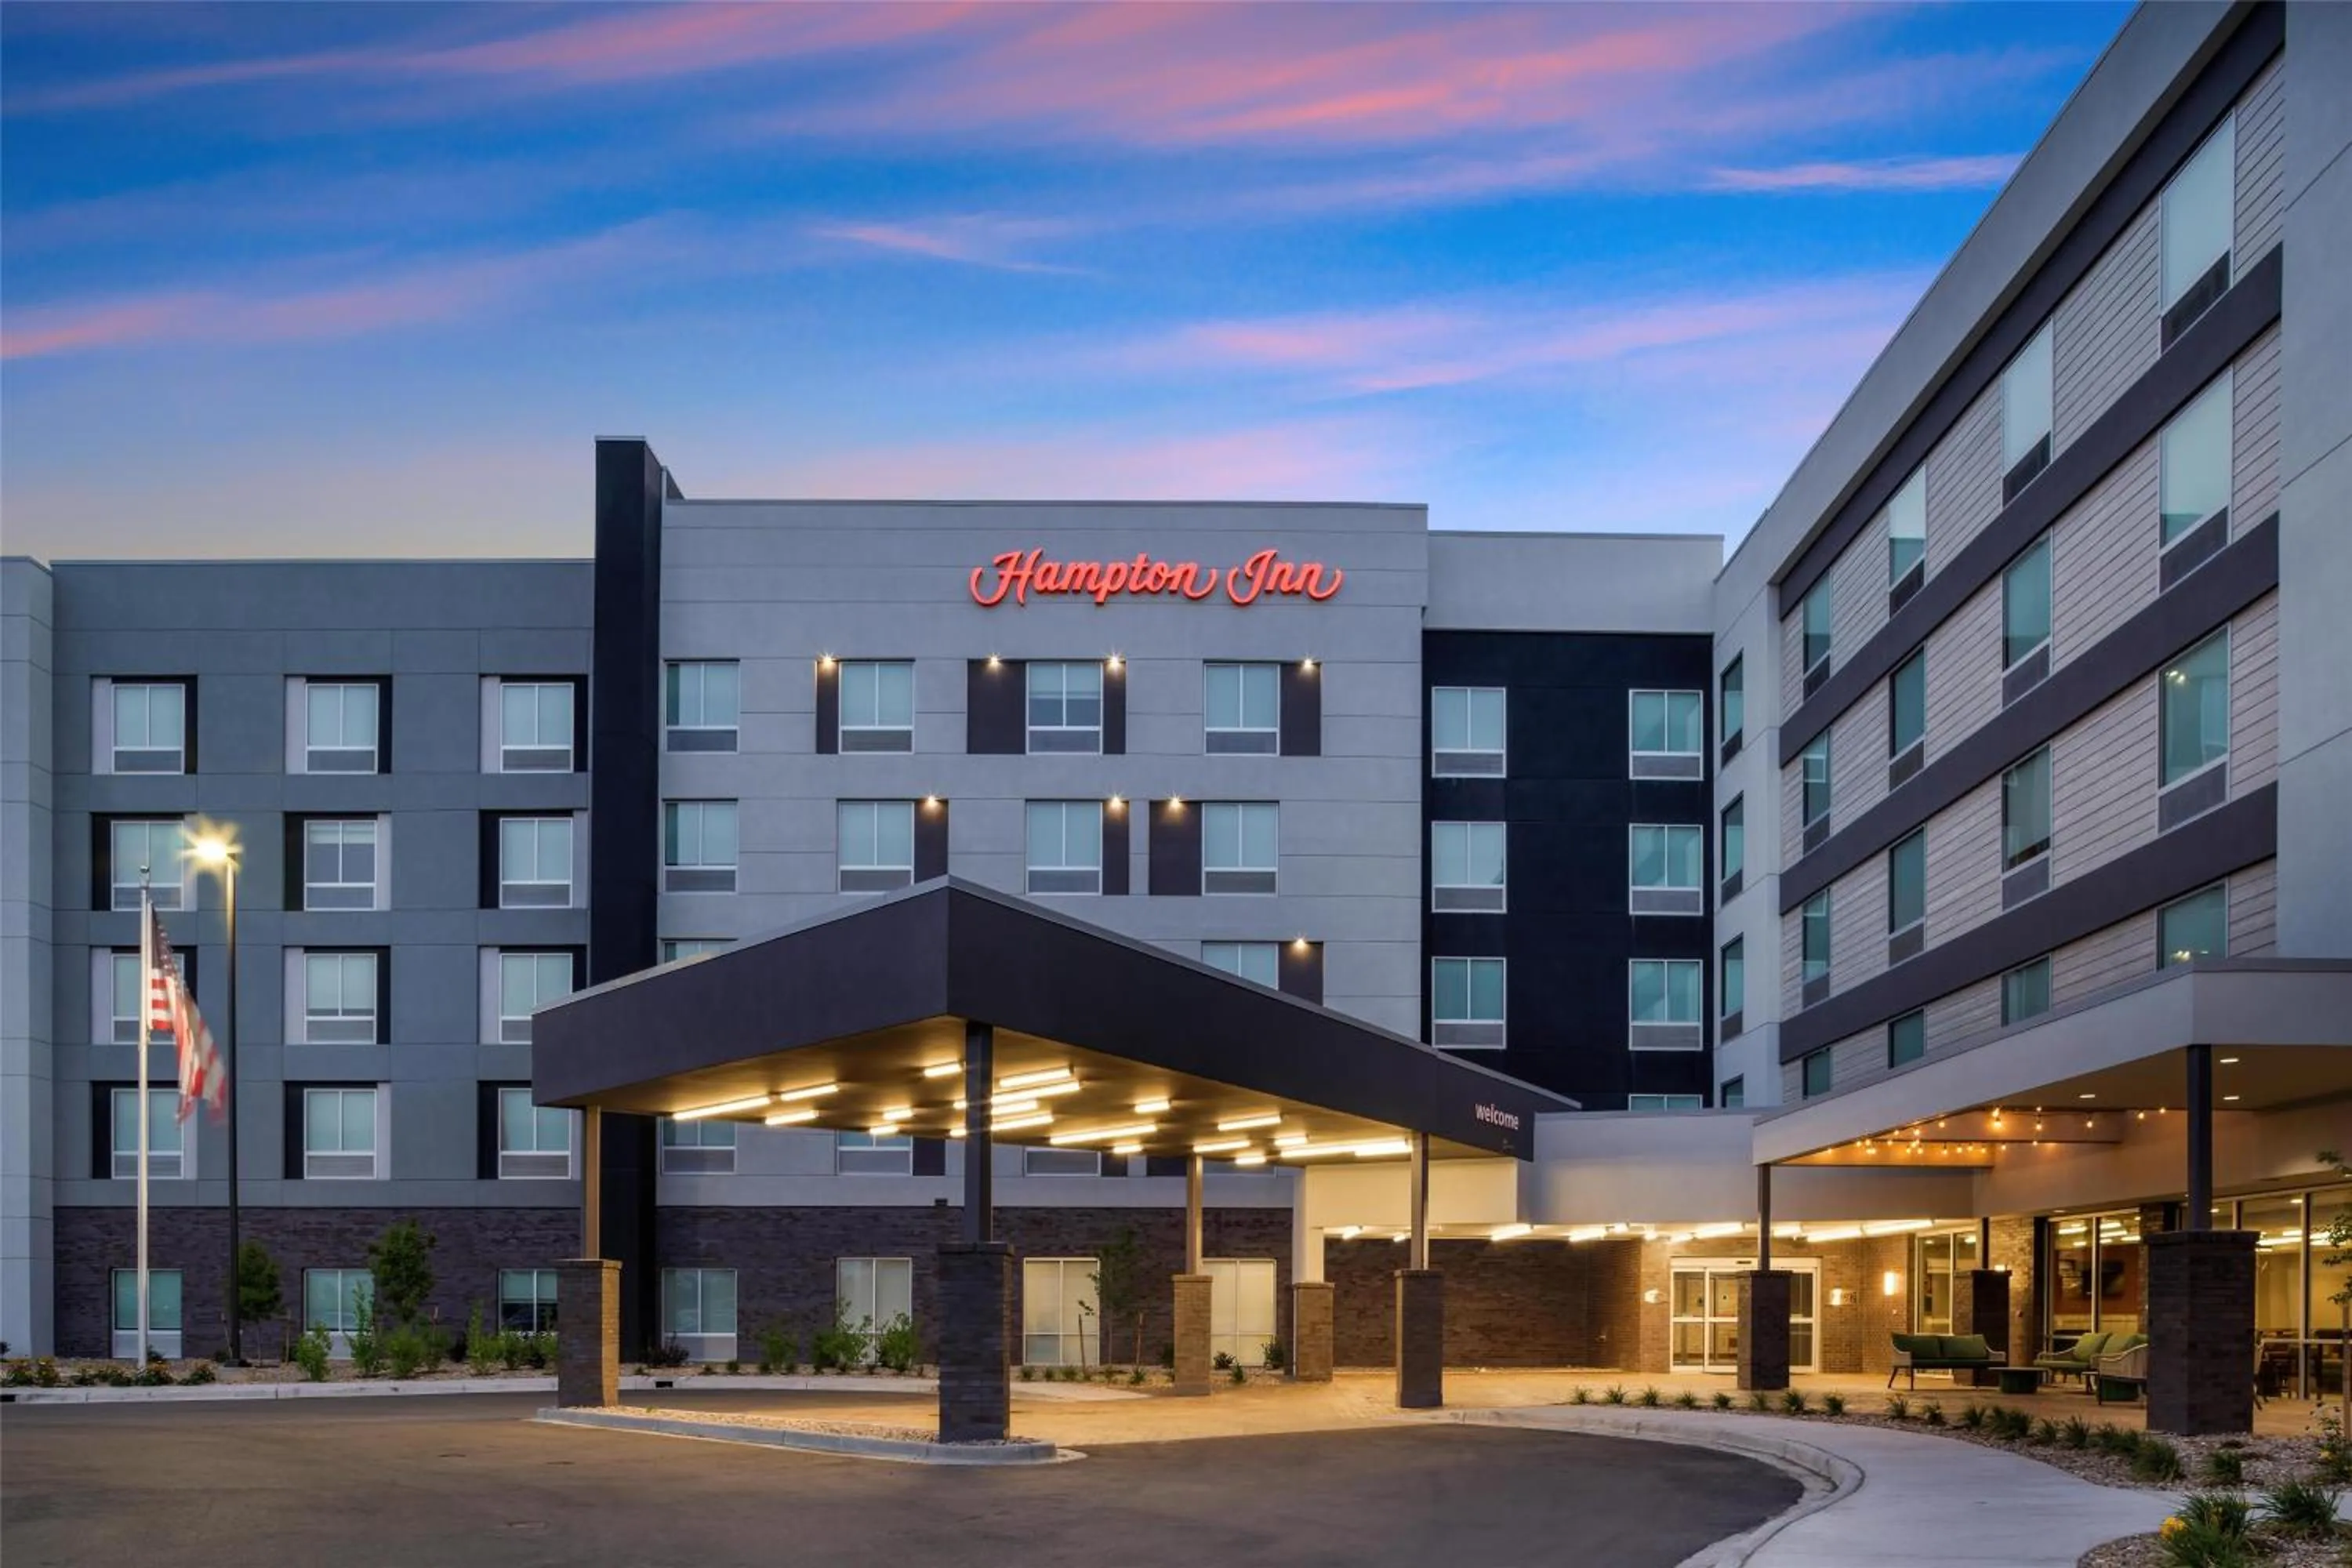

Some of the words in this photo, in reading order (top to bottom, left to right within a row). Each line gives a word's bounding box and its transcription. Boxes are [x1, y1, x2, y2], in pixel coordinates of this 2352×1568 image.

[970, 548, 1218, 607] Hampton
[1225, 549, 1343, 606] Inn
[1475, 1103, 1519, 1130] welcome
